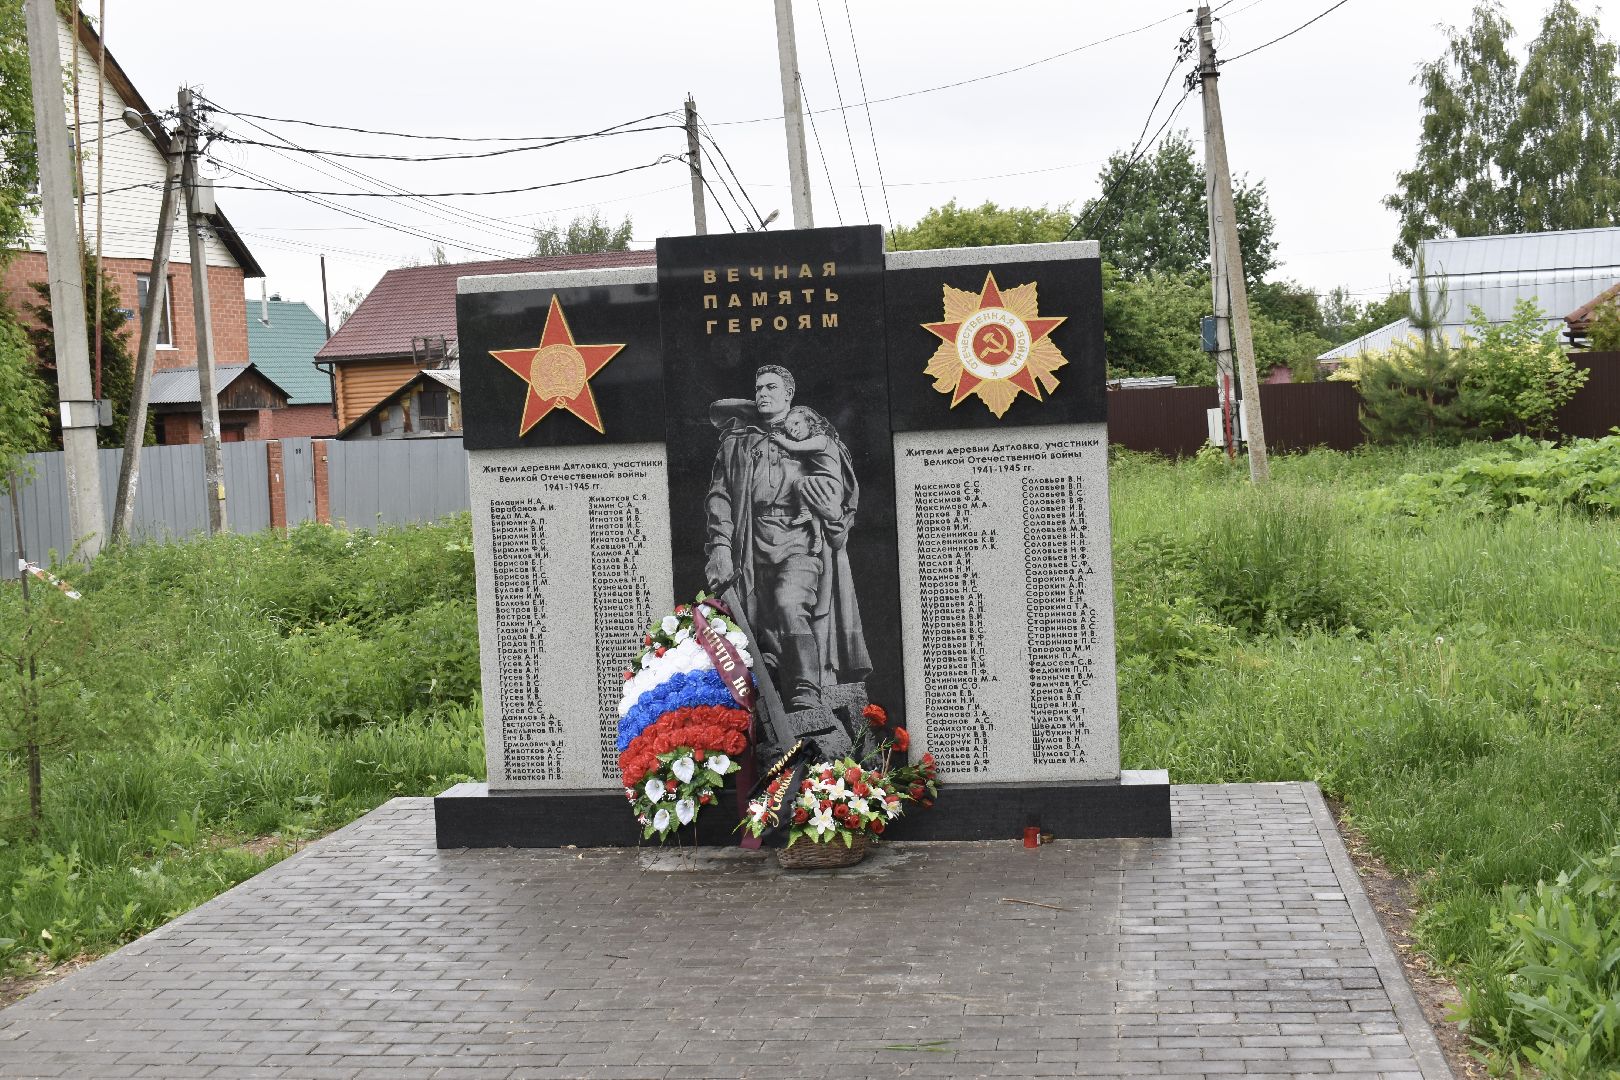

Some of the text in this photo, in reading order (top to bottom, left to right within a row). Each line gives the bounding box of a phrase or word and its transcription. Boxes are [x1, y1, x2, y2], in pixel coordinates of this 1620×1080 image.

[703, 262, 836, 284] ВЕЧНАЯ
[704, 288, 839, 309] ПАМЯТЬ
[706, 314, 838, 334] ГЕРОЯМ
[961, 312, 1028, 369] ОТЕЧЕСТВЕННАЯ ВОЙНА
[947, 446, 989, 455] деревни
[992, 444, 1042, 452] Дятловка,
[1045, 440, 1099, 450] участники
[613, 460, 663, 469] участники
[924, 450, 1082, 466] Великой Отечественной войны
[500, 470, 647, 482] Великой Отечественной войны
[972, 464, 1021, 474] 1941-1945
[544, 483, 589, 491] 1941-1945
[1026, 576, 1064, 584] Сорокин
